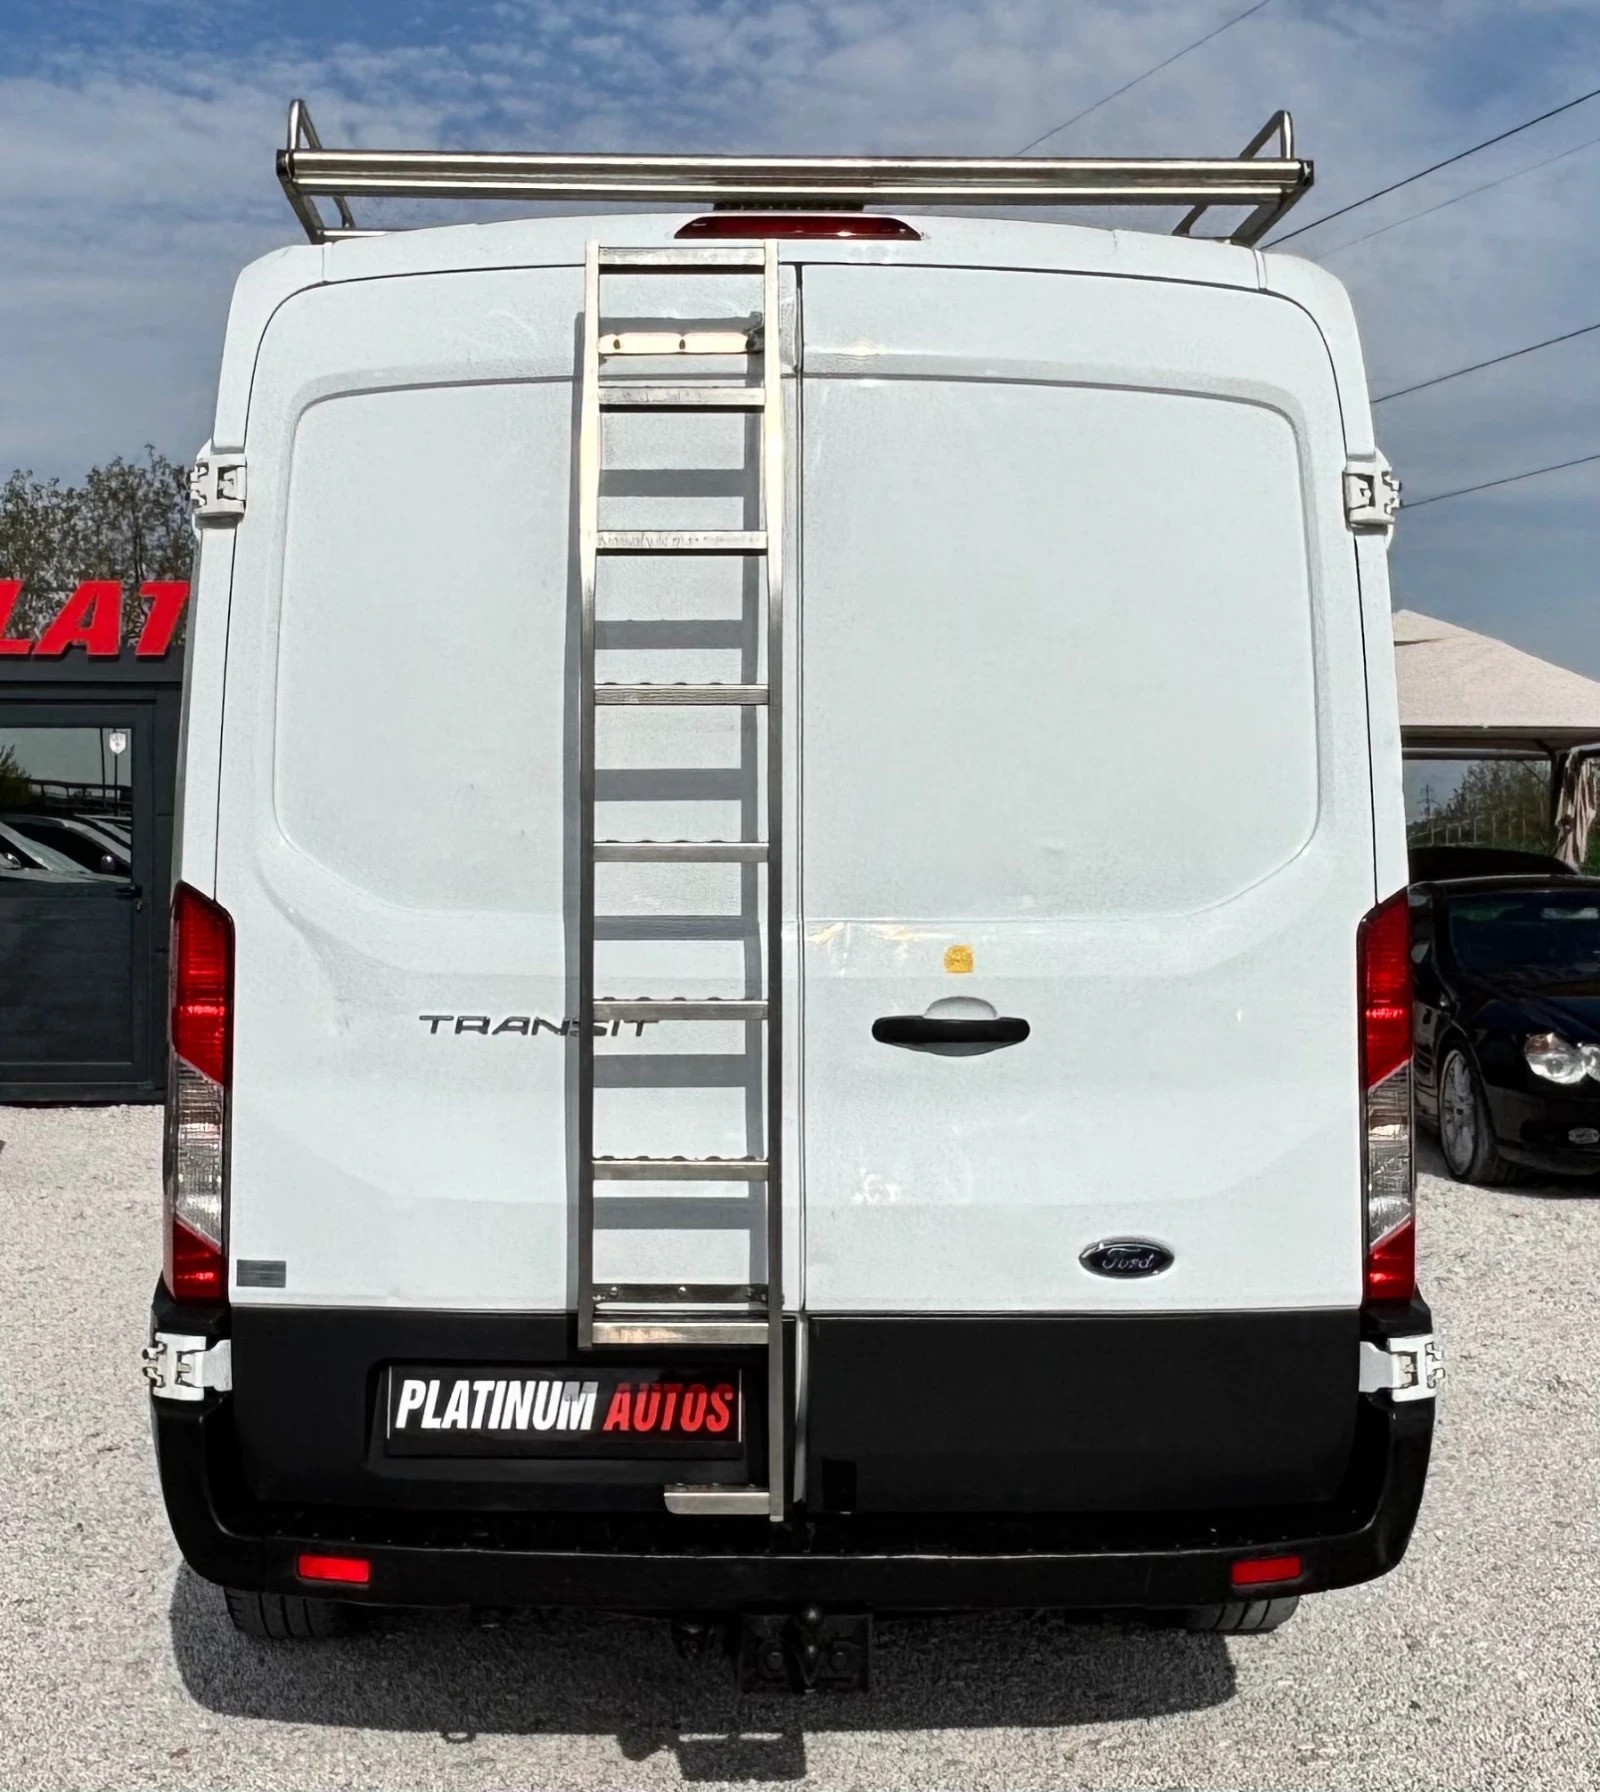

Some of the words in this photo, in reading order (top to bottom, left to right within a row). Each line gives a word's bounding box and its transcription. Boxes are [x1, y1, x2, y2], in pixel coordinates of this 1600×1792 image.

[1102, 1247, 1155, 1269] Ford
[395, 1380, 598, 1431] PLATINUM
[603, 1383, 734, 1432] AUTOS
